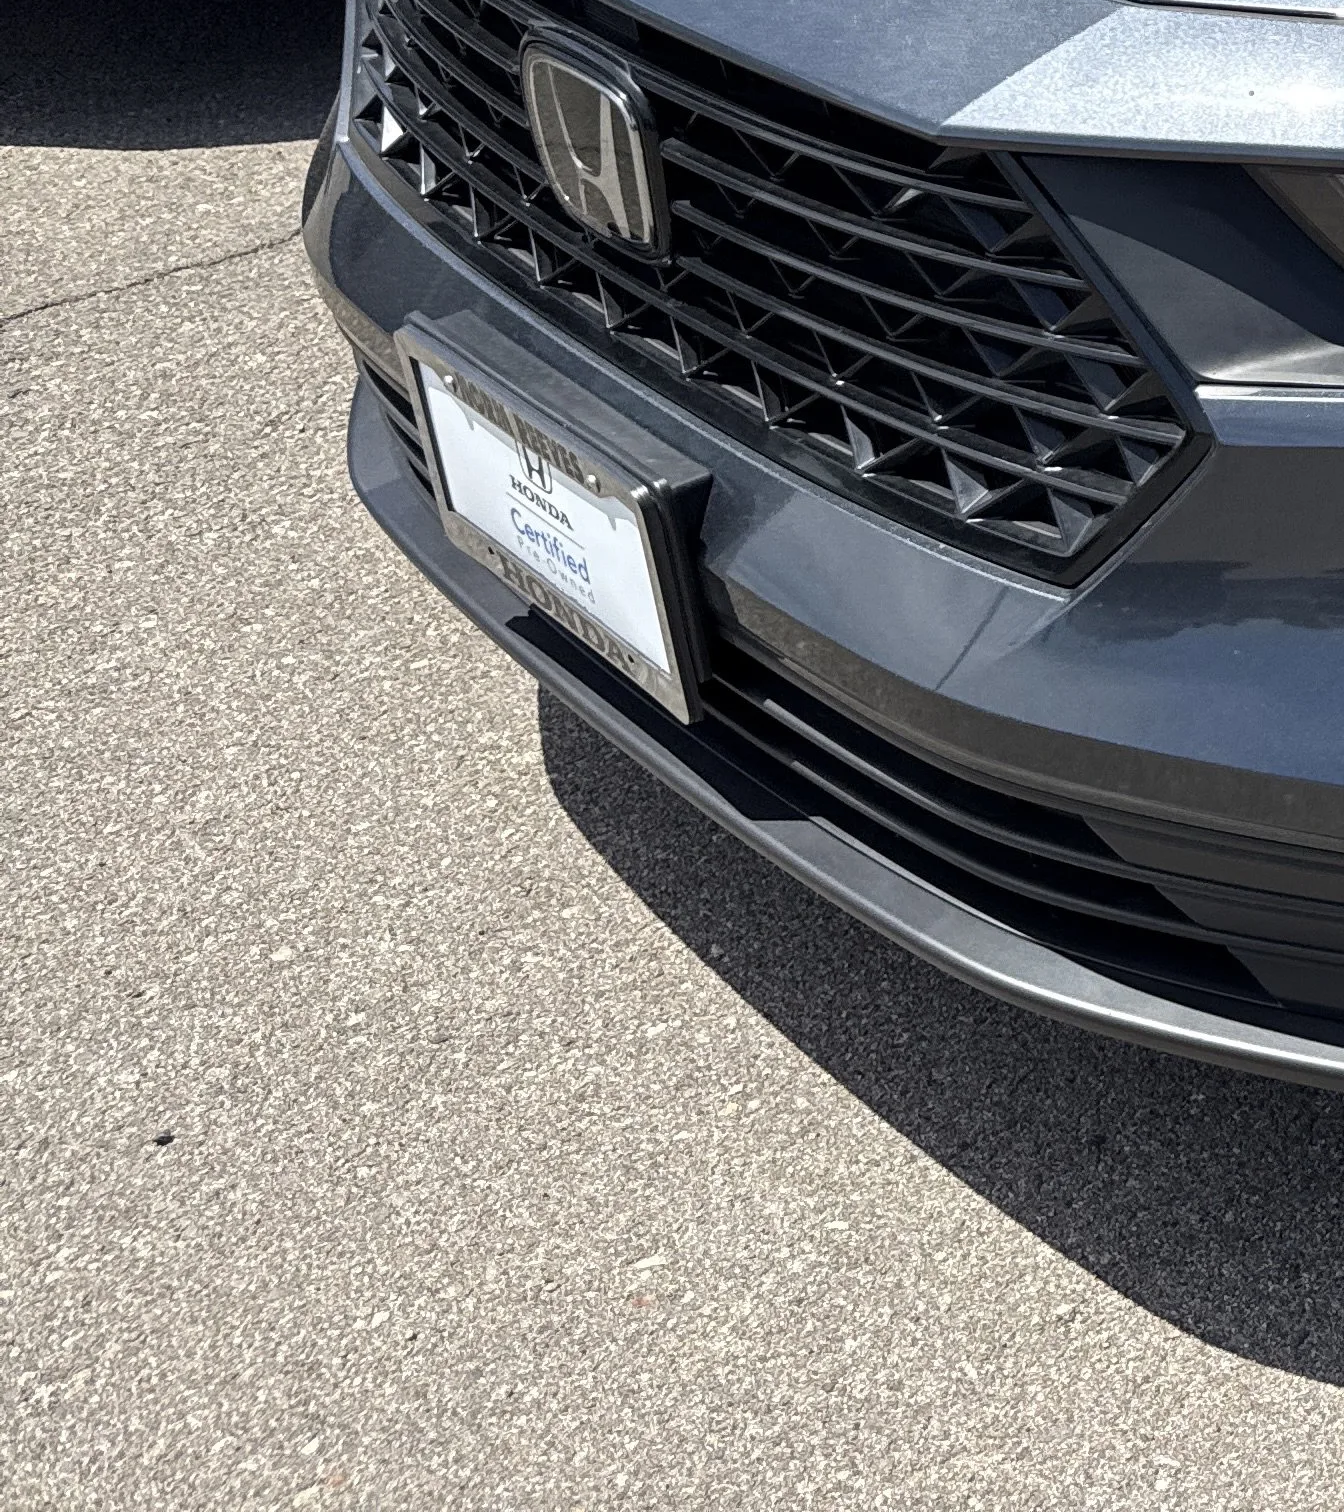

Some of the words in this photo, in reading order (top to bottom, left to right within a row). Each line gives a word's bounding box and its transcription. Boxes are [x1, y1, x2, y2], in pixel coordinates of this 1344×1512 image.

[515, 414, 586, 486] REEVES
[508, 474, 574, 532] HONDA
[509, 507, 591, 585] Certified
[497, 556, 633, 676] HONDA
